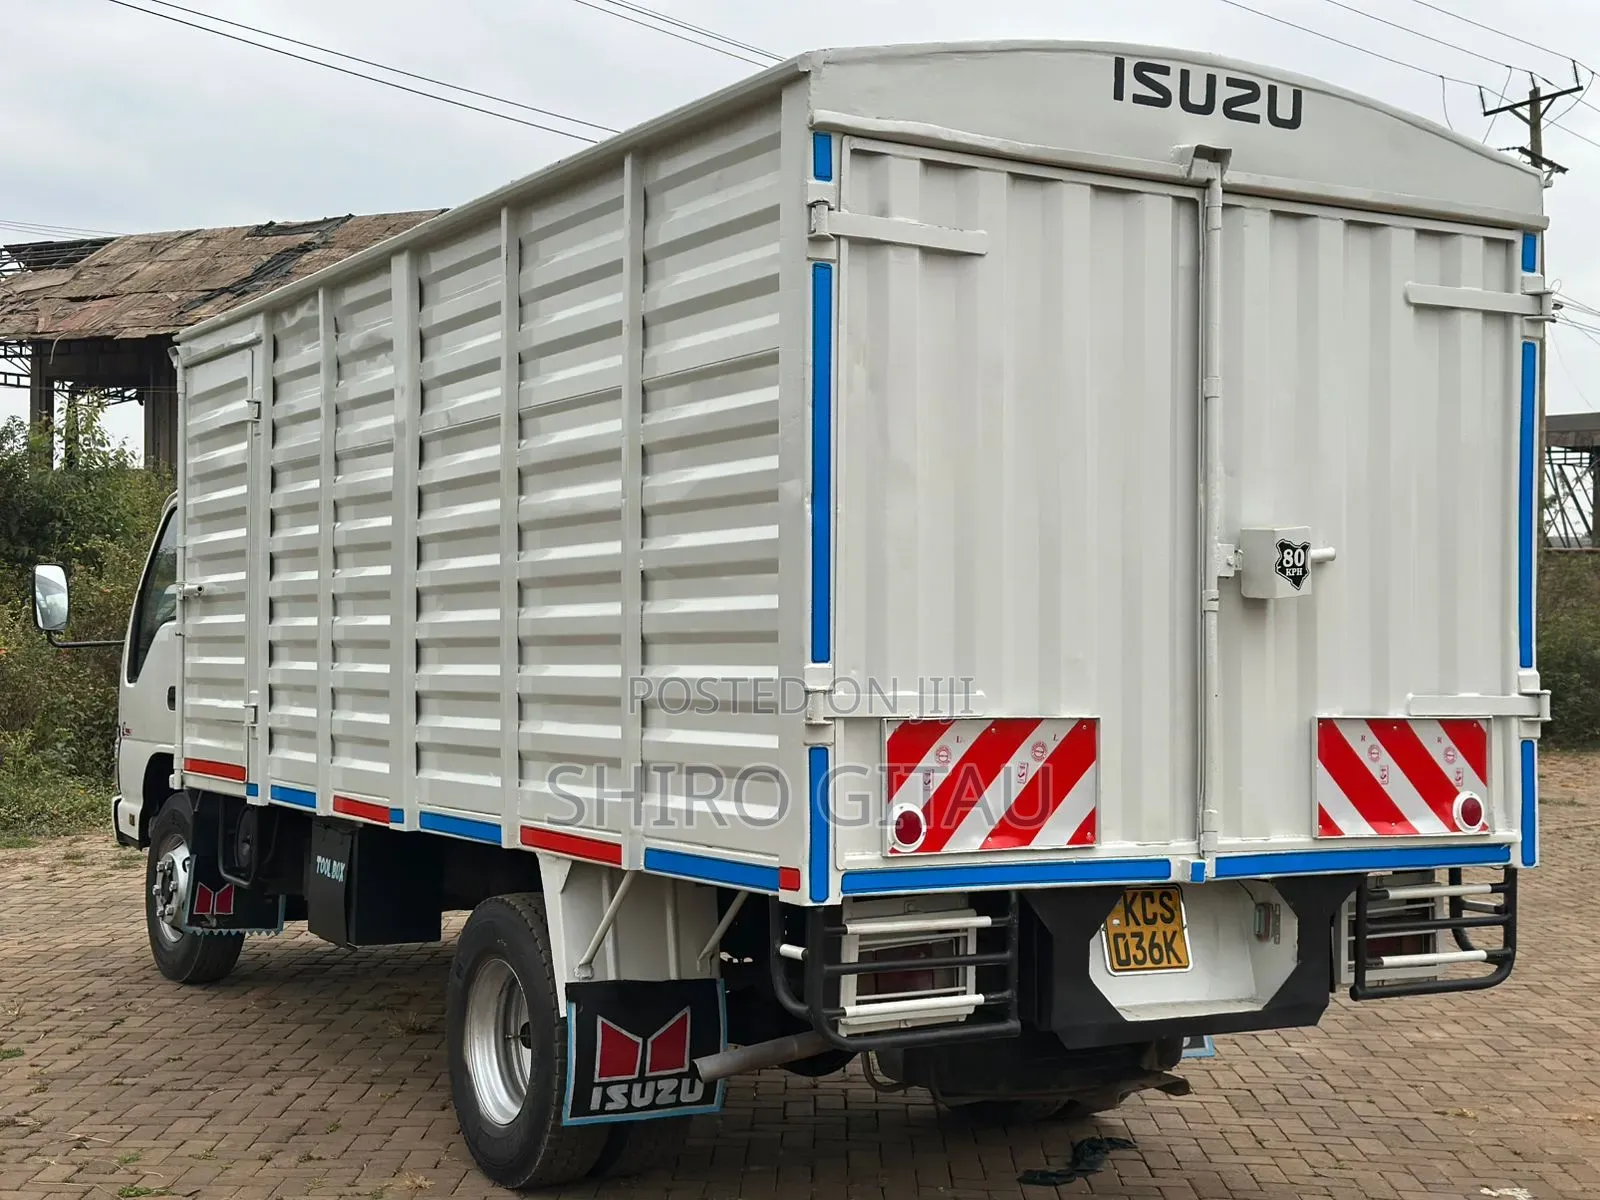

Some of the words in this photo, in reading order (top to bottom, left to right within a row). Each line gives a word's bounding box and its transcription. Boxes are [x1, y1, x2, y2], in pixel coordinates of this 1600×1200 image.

[1113, 56, 1303, 130] ISUZU
[1282, 548, 1305, 567] 80
[1285, 567, 1303, 576] KPH
[316, 855, 331, 878] TOOL
[331, 860, 345, 882] BOX
[1122, 890, 1176, 927] KCS
[1113, 930, 1183, 967] 036K
[590, 1078, 704, 1111] ISUZU
